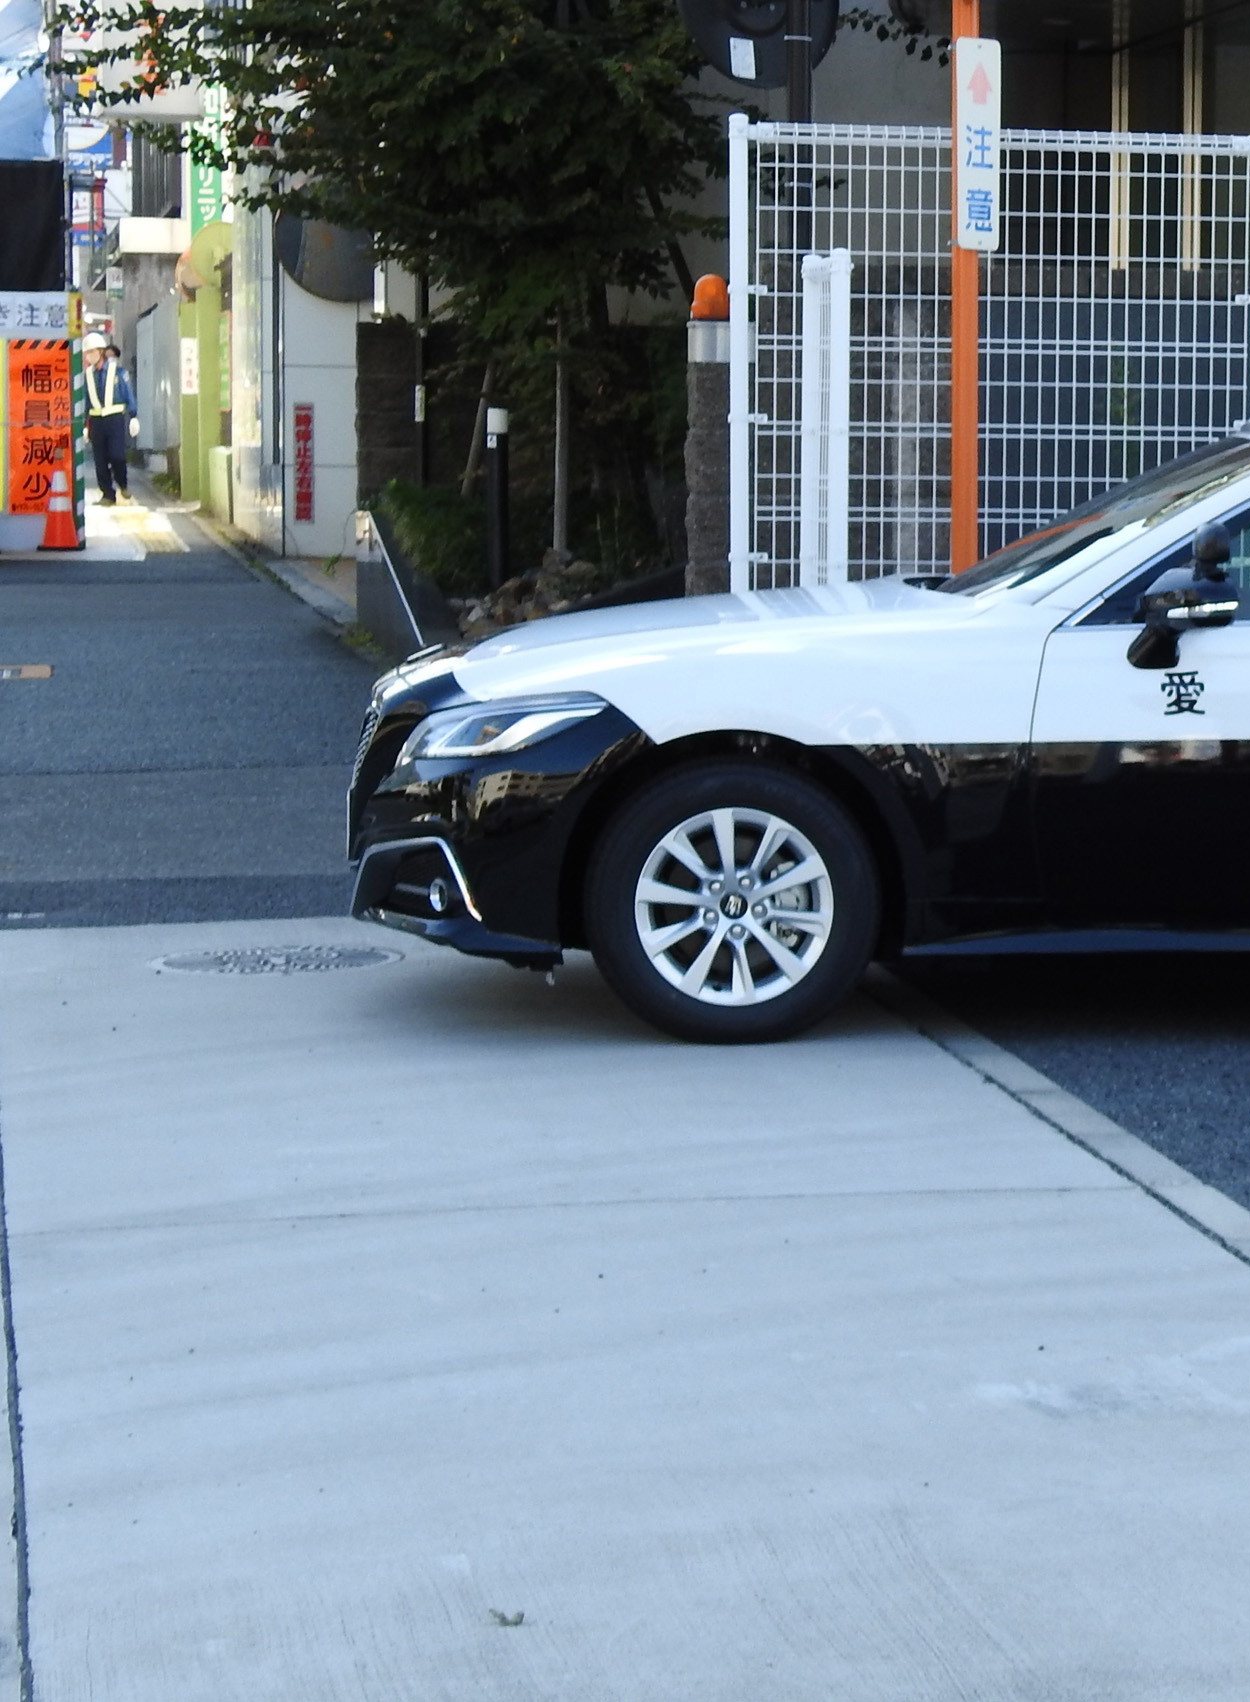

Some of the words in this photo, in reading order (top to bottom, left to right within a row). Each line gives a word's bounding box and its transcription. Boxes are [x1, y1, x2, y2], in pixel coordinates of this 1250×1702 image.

[965, 124, 993, 233] 注意
[21, 363, 55, 502] 幅員減少
